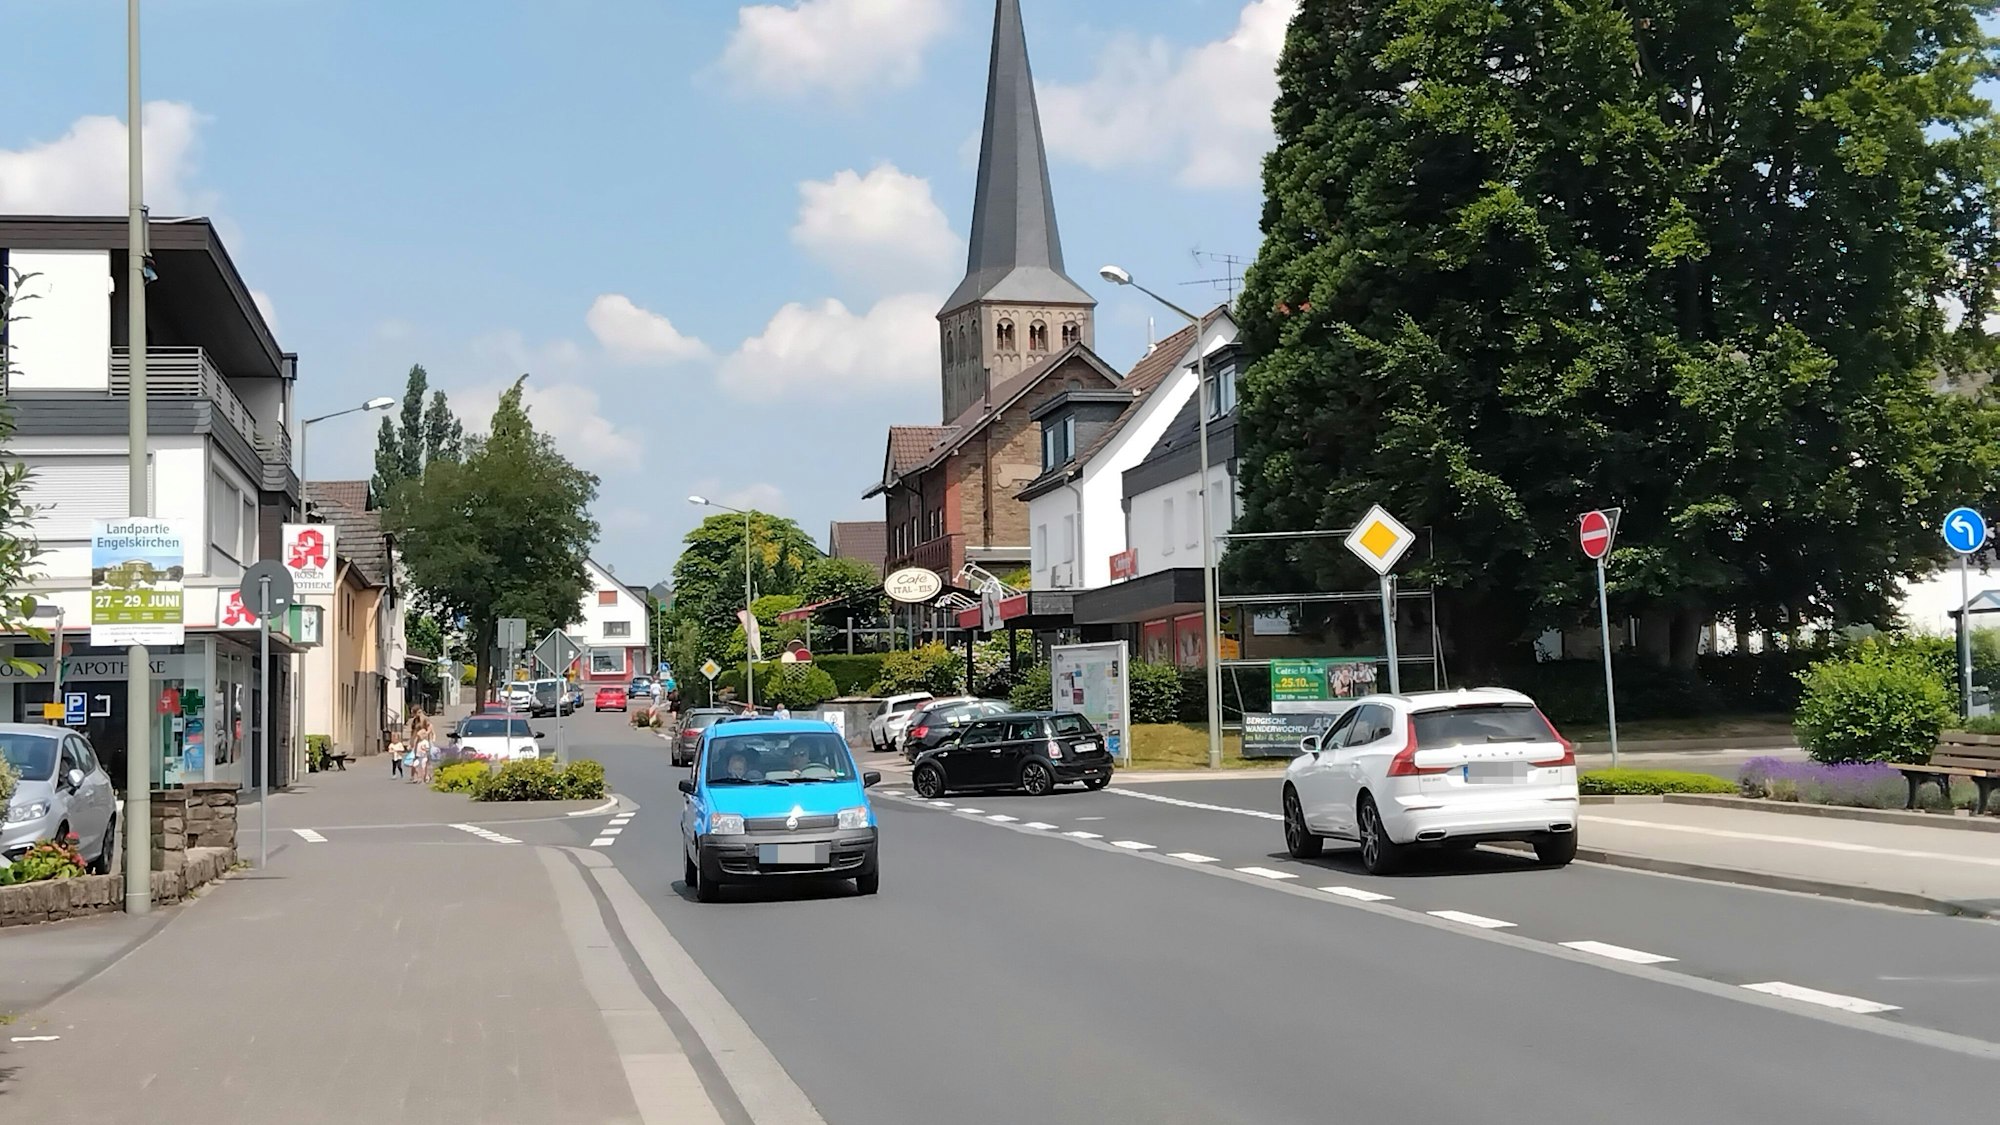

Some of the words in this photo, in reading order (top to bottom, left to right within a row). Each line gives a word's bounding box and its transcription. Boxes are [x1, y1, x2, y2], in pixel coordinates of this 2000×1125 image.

[106, 523, 170, 536] Landpartie
[97, 537, 180, 550] Engelskirchen
[294, 581, 332, 589] OTHEKE
[147, 594, 180, 607] JUNI
[72, 661, 166, 675] APOTHKE
[69, 695, 83, 711] P
[1246, 716, 1287, 725] BERGISCHE
[1245, 725, 1308, 733] WANDERWOCHEN
